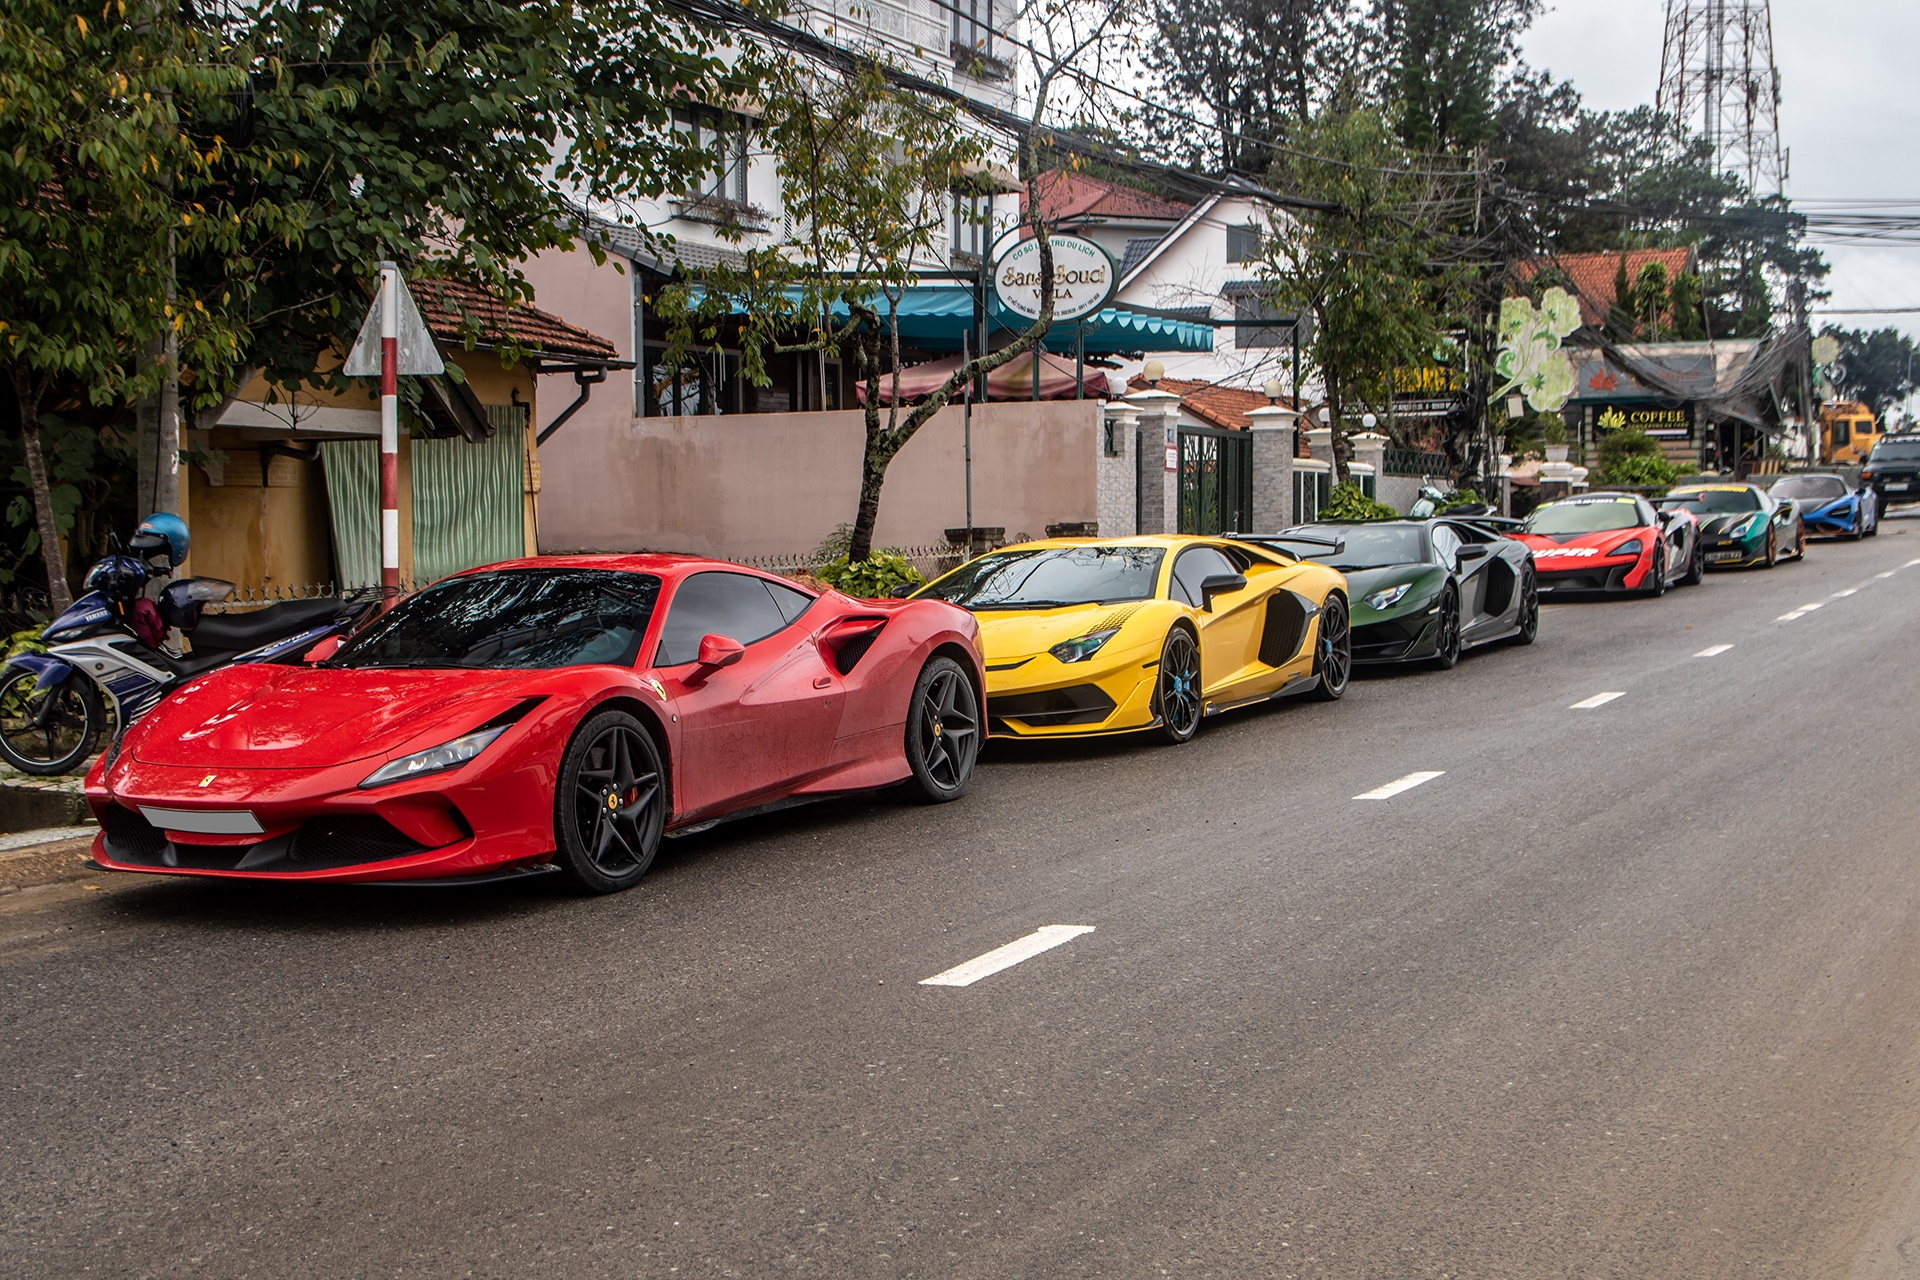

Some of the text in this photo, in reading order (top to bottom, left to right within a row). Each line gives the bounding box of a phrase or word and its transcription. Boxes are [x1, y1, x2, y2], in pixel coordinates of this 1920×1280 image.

[1013, 249, 1023, 260] CƠ
[1067, 241, 1077, 249] DU
[1053, 264, 1105, 284] Souci
[1033, 288, 1073, 299] VLA
[1630, 410, 1686, 423] COFFEE
[85, 609, 110, 622] YAMAHA
